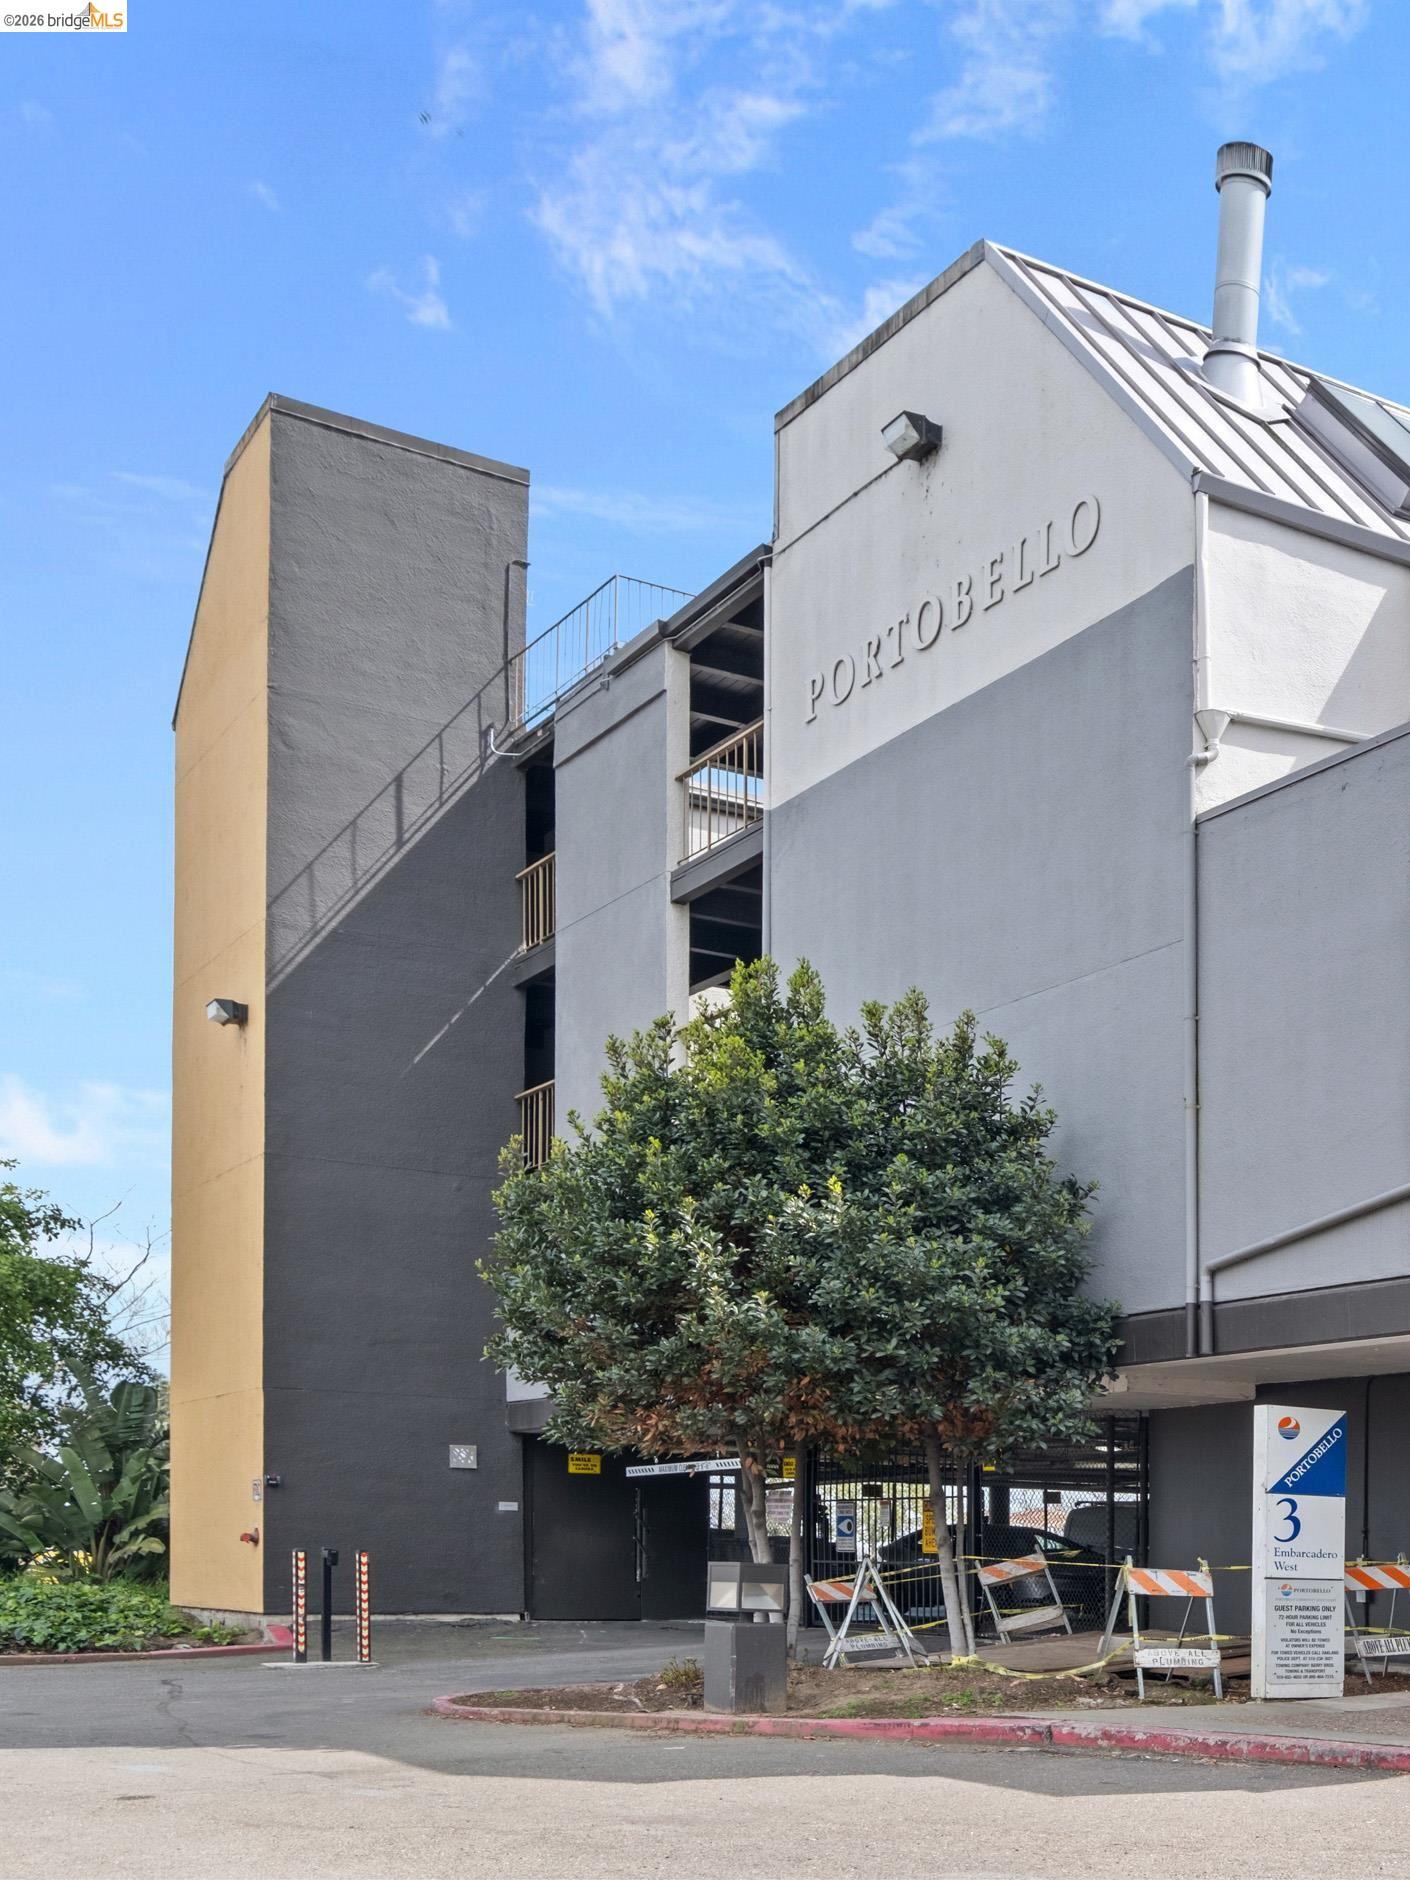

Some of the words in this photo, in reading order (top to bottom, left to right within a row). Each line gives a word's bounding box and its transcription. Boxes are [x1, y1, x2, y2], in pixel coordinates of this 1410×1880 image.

[805, 495, 1101, 725] PORTOBELLO
[1284, 1428, 1343, 1488] PORTOBELLO
[1273, 1497, 1302, 1543] 3
[1274, 1547, 1338, 1559] Embarcadero
[1274, 1561, 1298, 1571] West
[1152, 1657, 1204, 1666] PLUMBING
